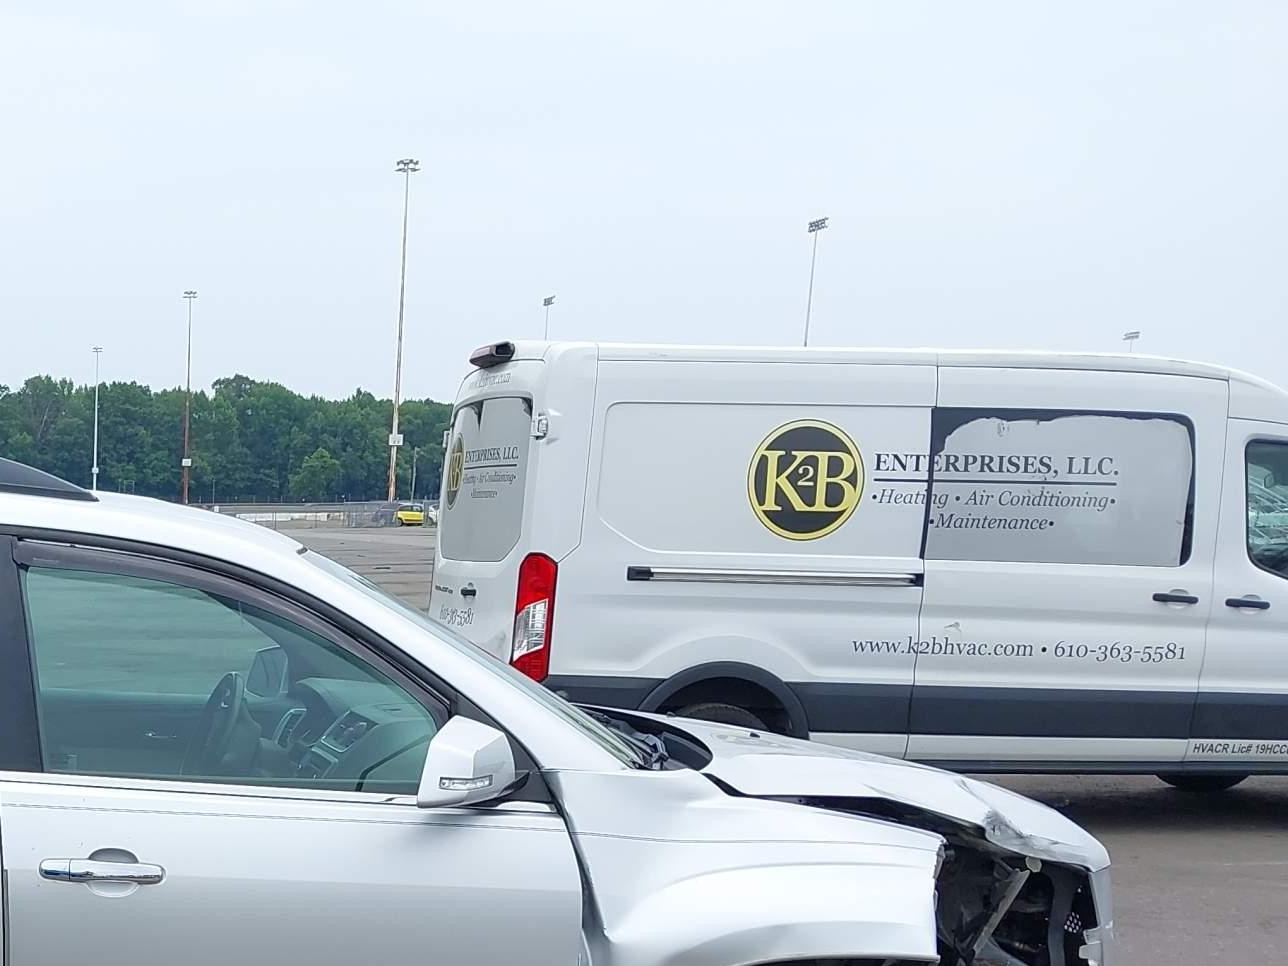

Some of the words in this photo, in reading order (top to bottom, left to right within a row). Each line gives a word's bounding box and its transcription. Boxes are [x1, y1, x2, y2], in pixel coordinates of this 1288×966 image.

[873, 453, 1059, 478] ENTERPRISES,
[1066, 456, 1119, 477] LLC.
[964, 489, 994, 507] Air
[852, 636, 1034, 657] www.k2bhvac.com
[1053, 640, 1186, 663] 610-363-5581
[1193, 743, 1230, 754] HVACR
[1231, 743, 1253, 754] Lic#
[1255, 743, 1288, 754] 19HCC
